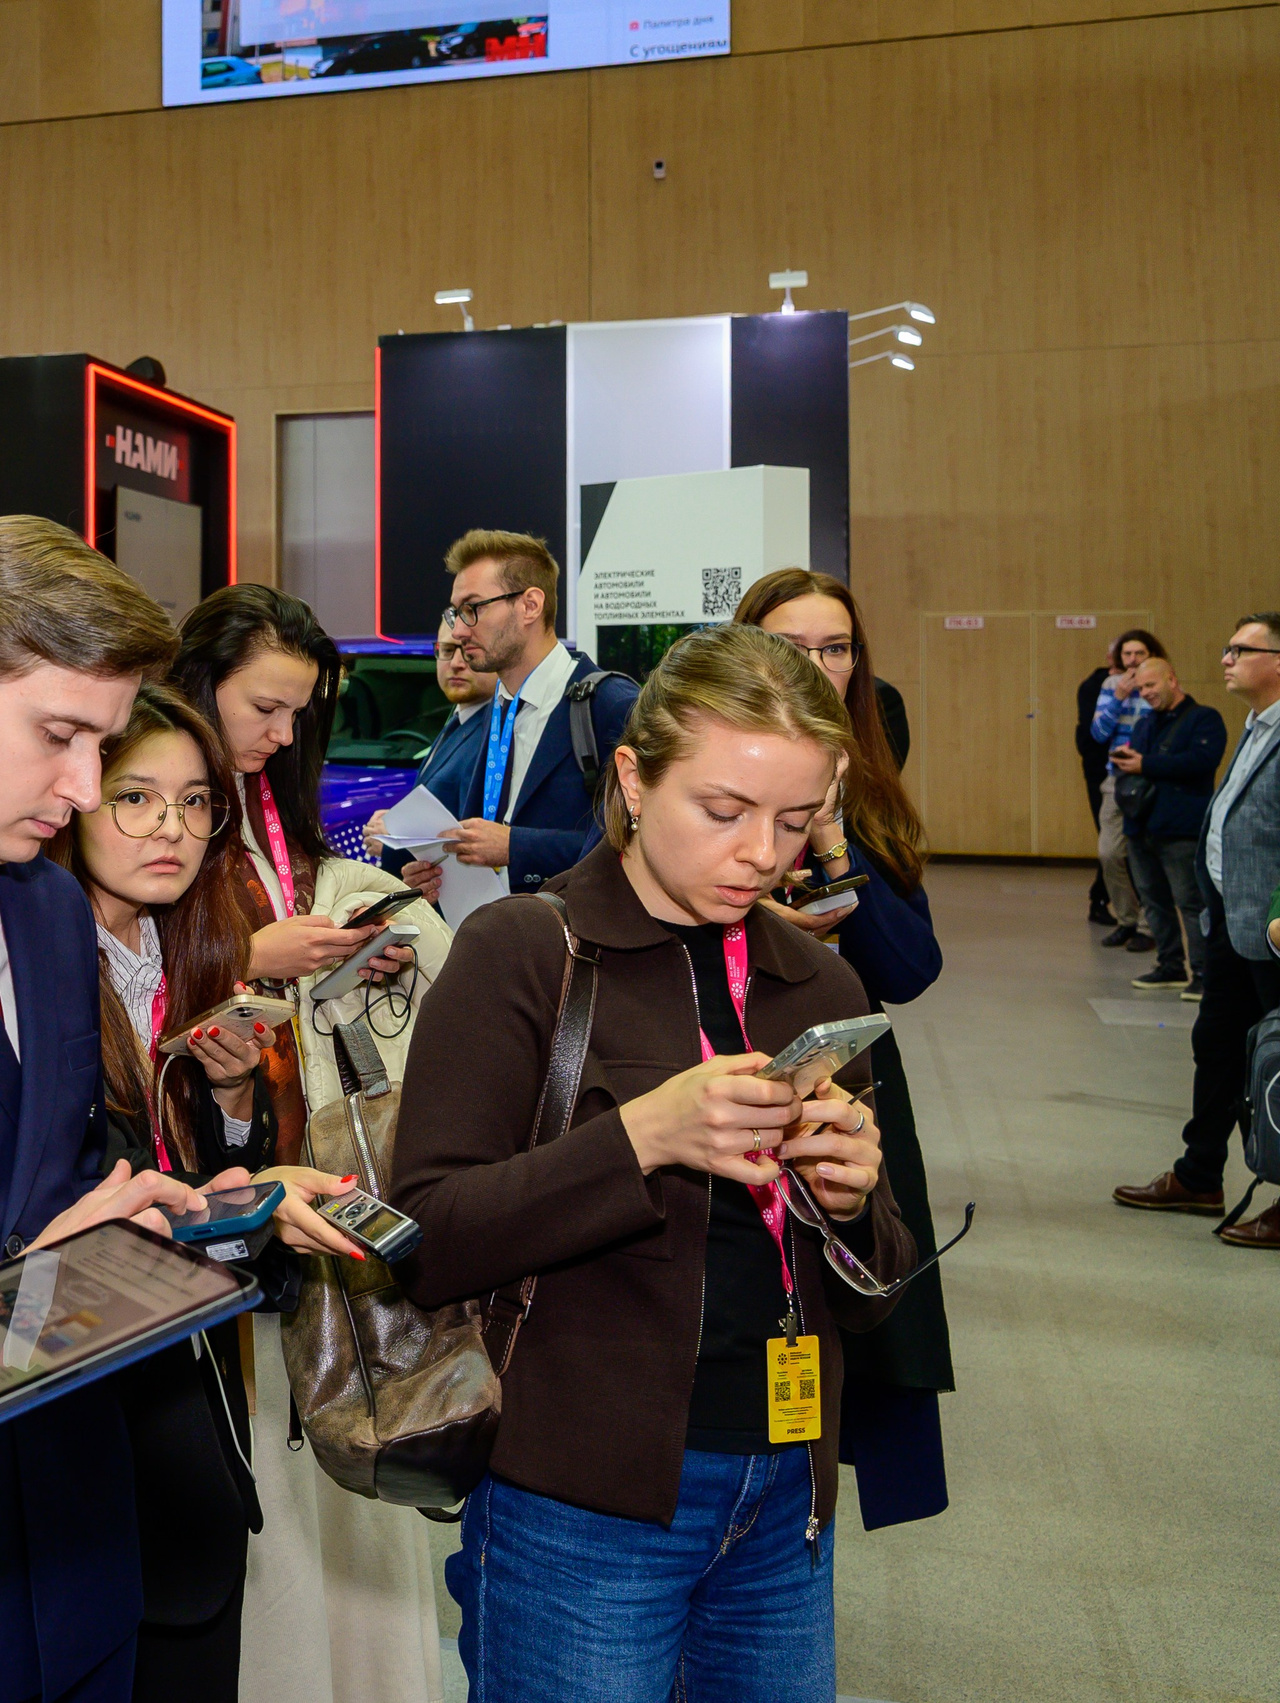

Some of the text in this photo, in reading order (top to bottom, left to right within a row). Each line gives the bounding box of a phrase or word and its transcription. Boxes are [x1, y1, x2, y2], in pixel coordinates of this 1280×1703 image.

[115, 425, 178, 481] НАМИ
[594, 570, 655, 580] ЭЛЕКТРИЧЕСКИЕ
[594, 581, 645, 590] АВТОМОБИЛИ
[594, 591, 652, 600] И АВТОМОБИЛИ
[605, 601, 657, 610] ВОДОРОДНЫХ
[594, 610, 686, 621] ТОПЛИВНЫХ ЭЛЕМЕНТАХ
